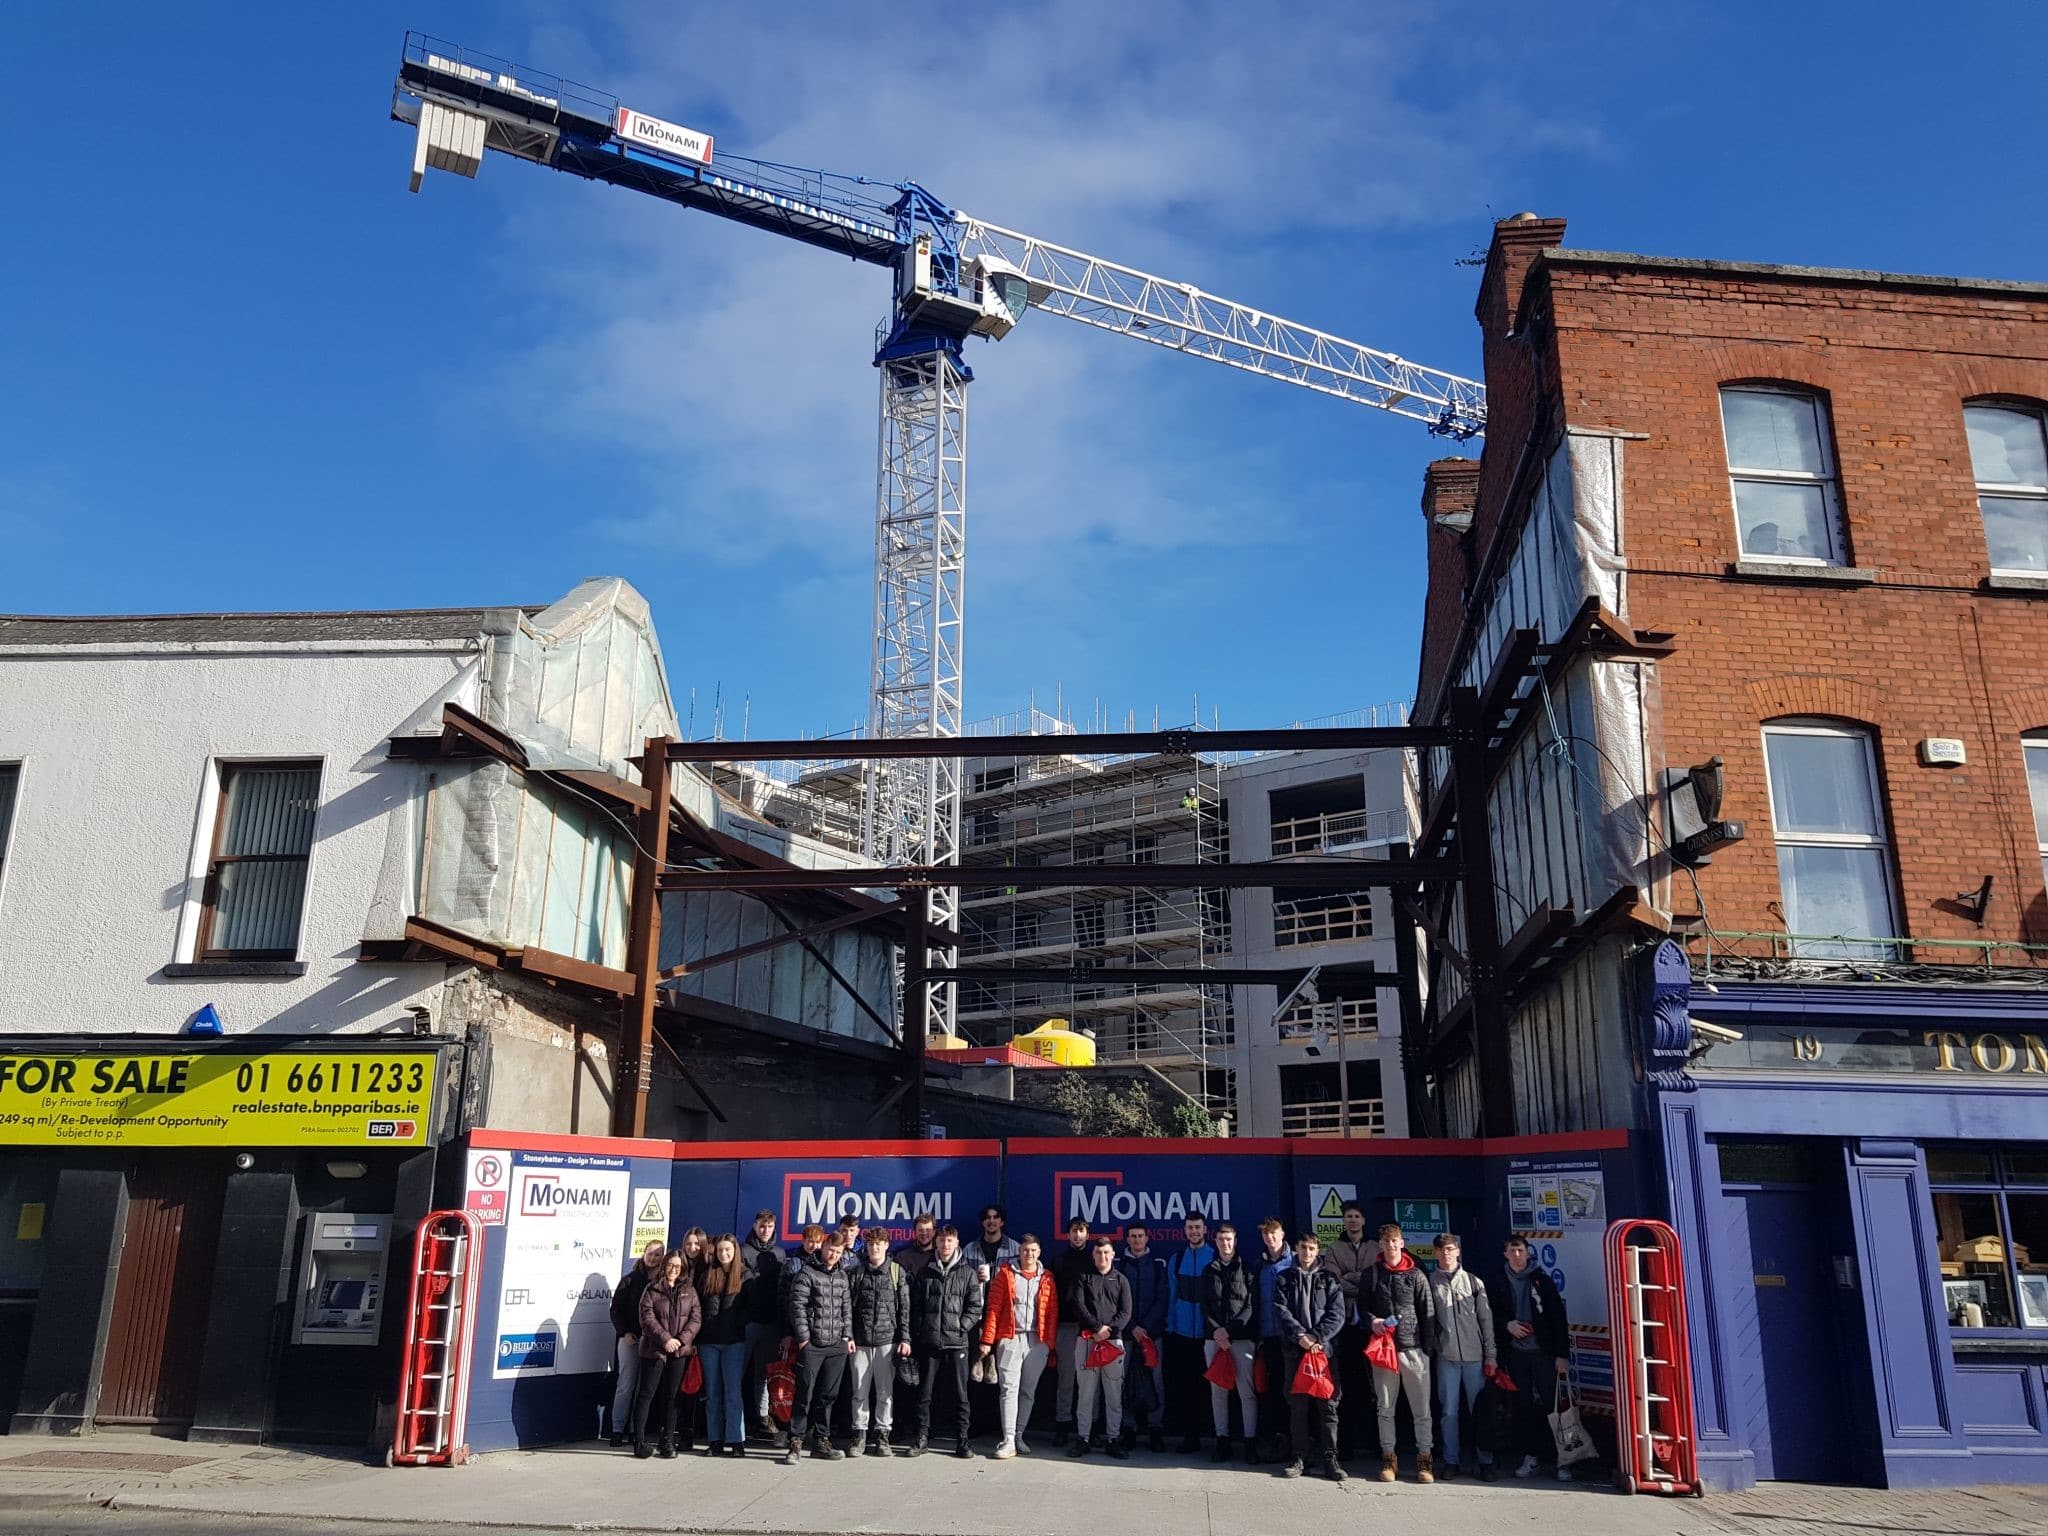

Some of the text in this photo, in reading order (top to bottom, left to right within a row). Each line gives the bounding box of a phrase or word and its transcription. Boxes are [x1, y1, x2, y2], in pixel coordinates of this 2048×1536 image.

[639, 121, 699, 150] MONAMI
[713, 177, 775, 204] ALLEN
[1792, 1035, 1822, 1061] 19
[0, 1060, 189, 1093] FOR SALE
[237, 1063, 423, 1093] 01 6611233
[42, 1097, 128, 1108] (By Private Treaty)
[232, 1100, 419, 1117] realestate.bnpparibas.ie
[22, 1117, 34, 1127] sq
[158, 1115, 229, 1129] Opportunity
[371, 1125, 409, 1134] BER F
[56, 1128, 125, 1140] Subject to p.p.
[523, 1154, 564, 1163] Stoneybatter
[568, 1157, 588, 1165] Design
[481, 1194, 492, 1205] NO
[529, 1184, 611, 1206] MONAMI
[797, 1187, 951, 1224] MONAMI
[1070, 1185, 1230, 1223] MONAMI
[636, 1228, 665, 1236] BEWARE
[1317, 1224, 1346, 1233] DANGE
[1424, 1222, 1444, 1230] EXIT
